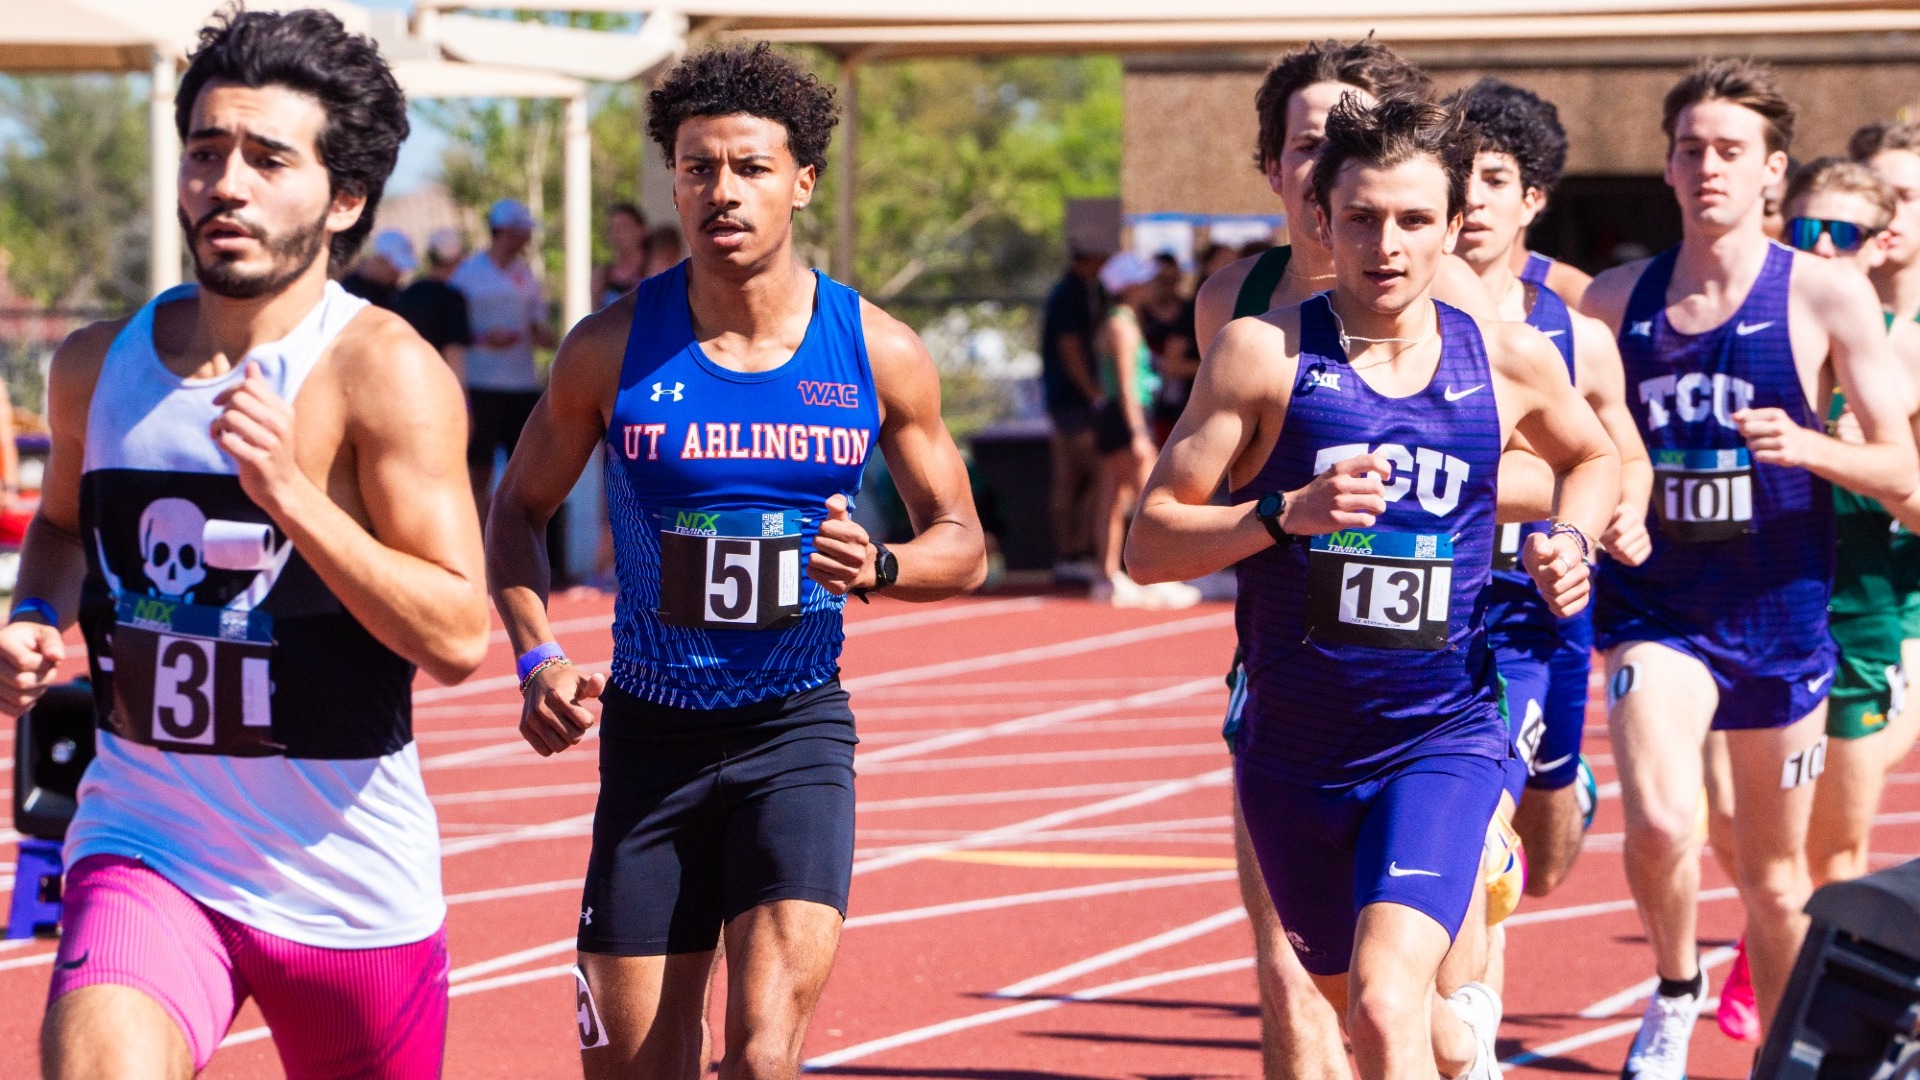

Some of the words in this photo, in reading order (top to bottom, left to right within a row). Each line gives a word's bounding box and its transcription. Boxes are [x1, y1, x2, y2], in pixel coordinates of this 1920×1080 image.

[797, 380, 859, 409] WAC
[1638, 372, 1754, 431] TCU
[623, 423, 666, 461] UT
[680, 422, 870, 466] ARLINGTON
[676, 511, 720, 531] NTX
[1668, 478, 1720, 521] 10
[675, 526, 718, 536] TIMING
[1327, 544, 1373, 555] TIMING
[1328, 531, 1378, 549] NTX
[709, 539, 753, 621] 5
[1345, 567, 1420, 625] 13
[158, 640, 211, 740] 3
